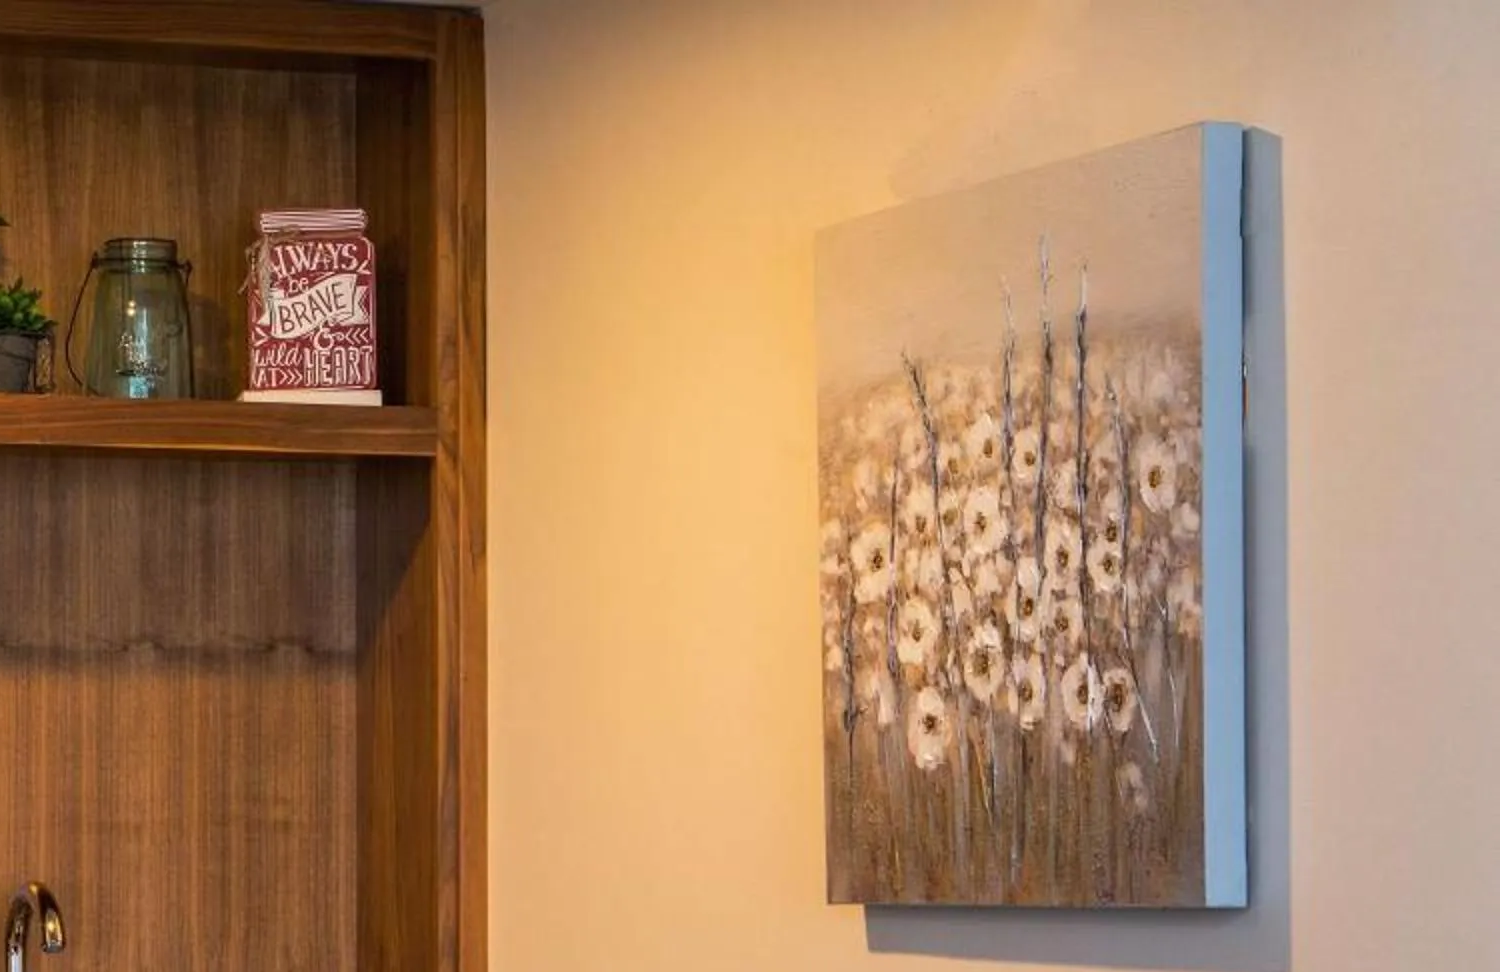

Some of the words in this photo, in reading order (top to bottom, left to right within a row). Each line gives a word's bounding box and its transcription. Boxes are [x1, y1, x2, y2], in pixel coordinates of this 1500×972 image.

[278, 281, 347, 334] BRAVE
[255, 342, 302, 368] wild
[256, 367, 279, 388] AT
[303, 345, 373, 387] HEART
